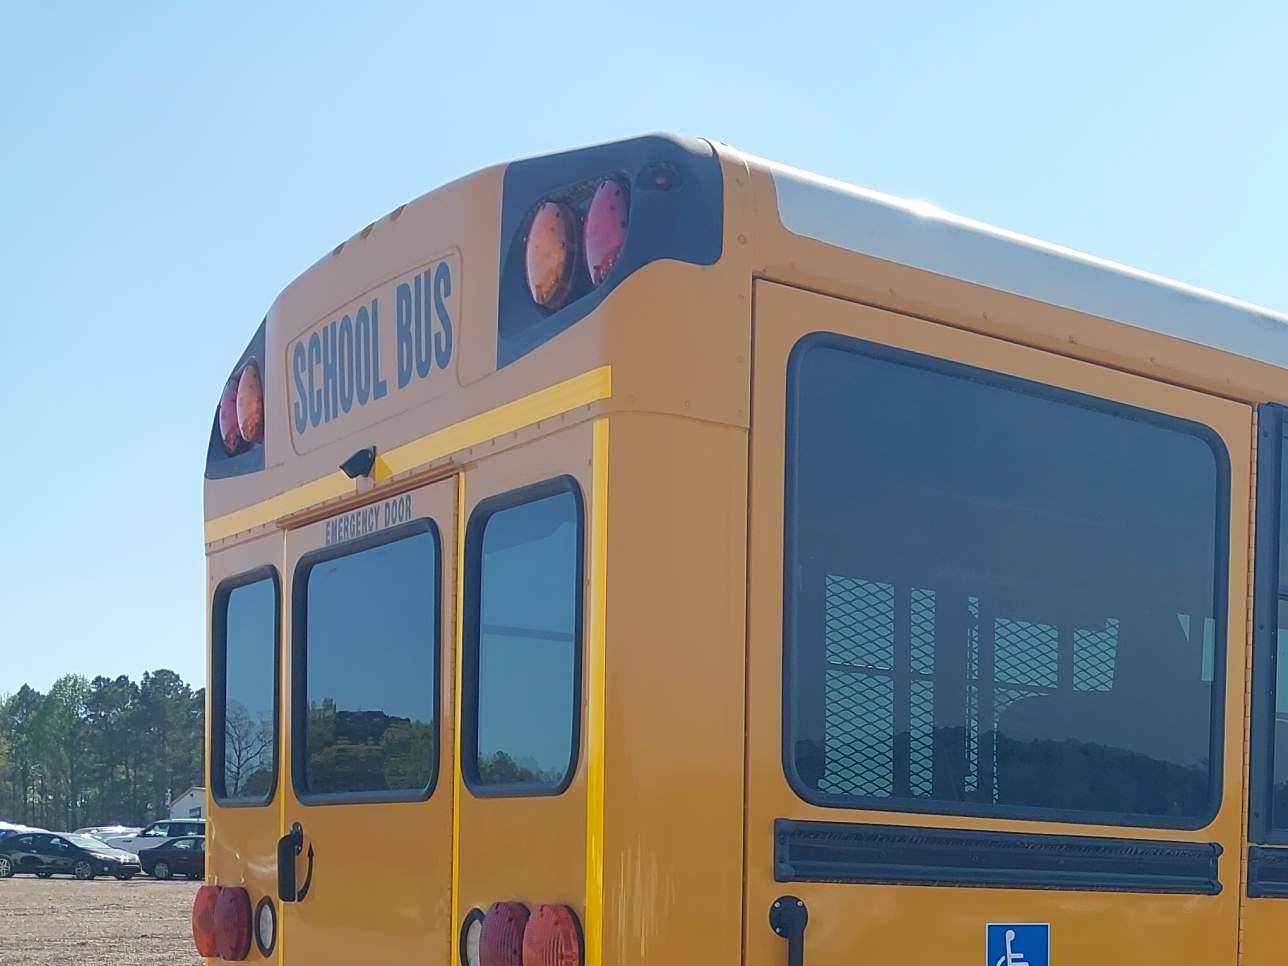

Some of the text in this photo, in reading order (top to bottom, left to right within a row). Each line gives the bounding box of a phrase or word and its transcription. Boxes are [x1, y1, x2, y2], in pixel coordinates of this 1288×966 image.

[294, 262, 453, 434] SCHOOL BUS
[325, 494, 412, 545] EMERGENCY DOOR
